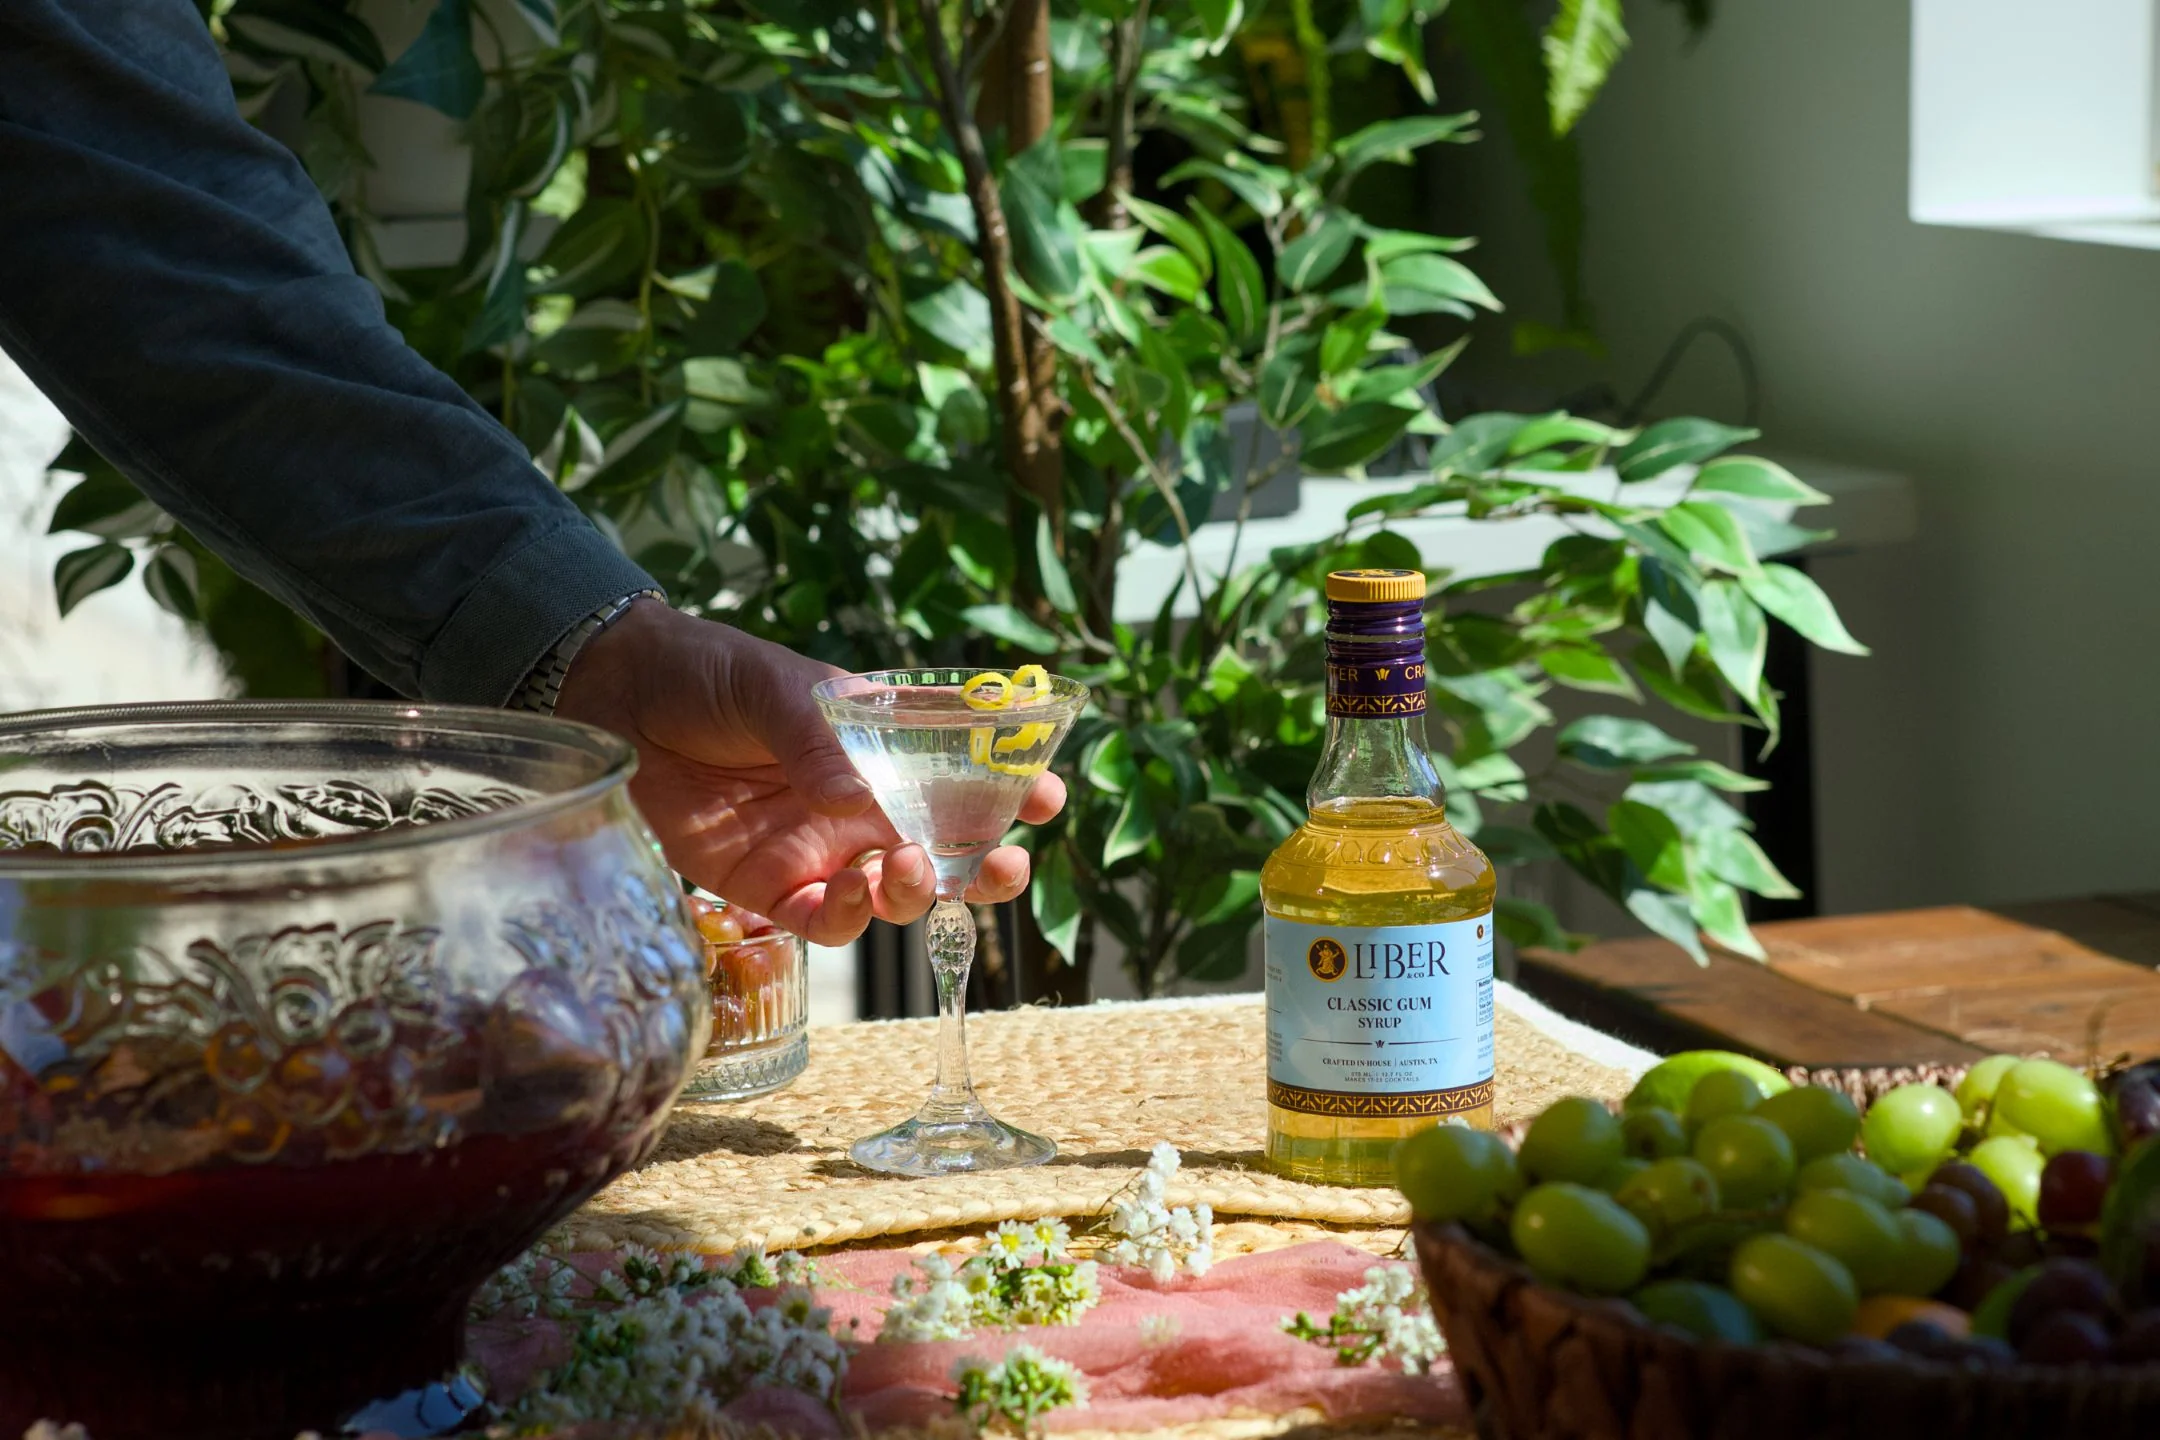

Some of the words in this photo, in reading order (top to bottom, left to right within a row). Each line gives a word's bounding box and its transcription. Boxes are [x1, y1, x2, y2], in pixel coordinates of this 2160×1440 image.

[1353, 941, 1451, 979] LIBER
[1327, 997, 1393, 1012] CLASSIC
[1397, 996, 1432, 1011] GUM
[1358, 1017, 1402, 1029] SYRUP
[1322, 1058, 1356, 1066] CRAFTED
[1357, 1059, 1392, 1067] IN-HOUSE
